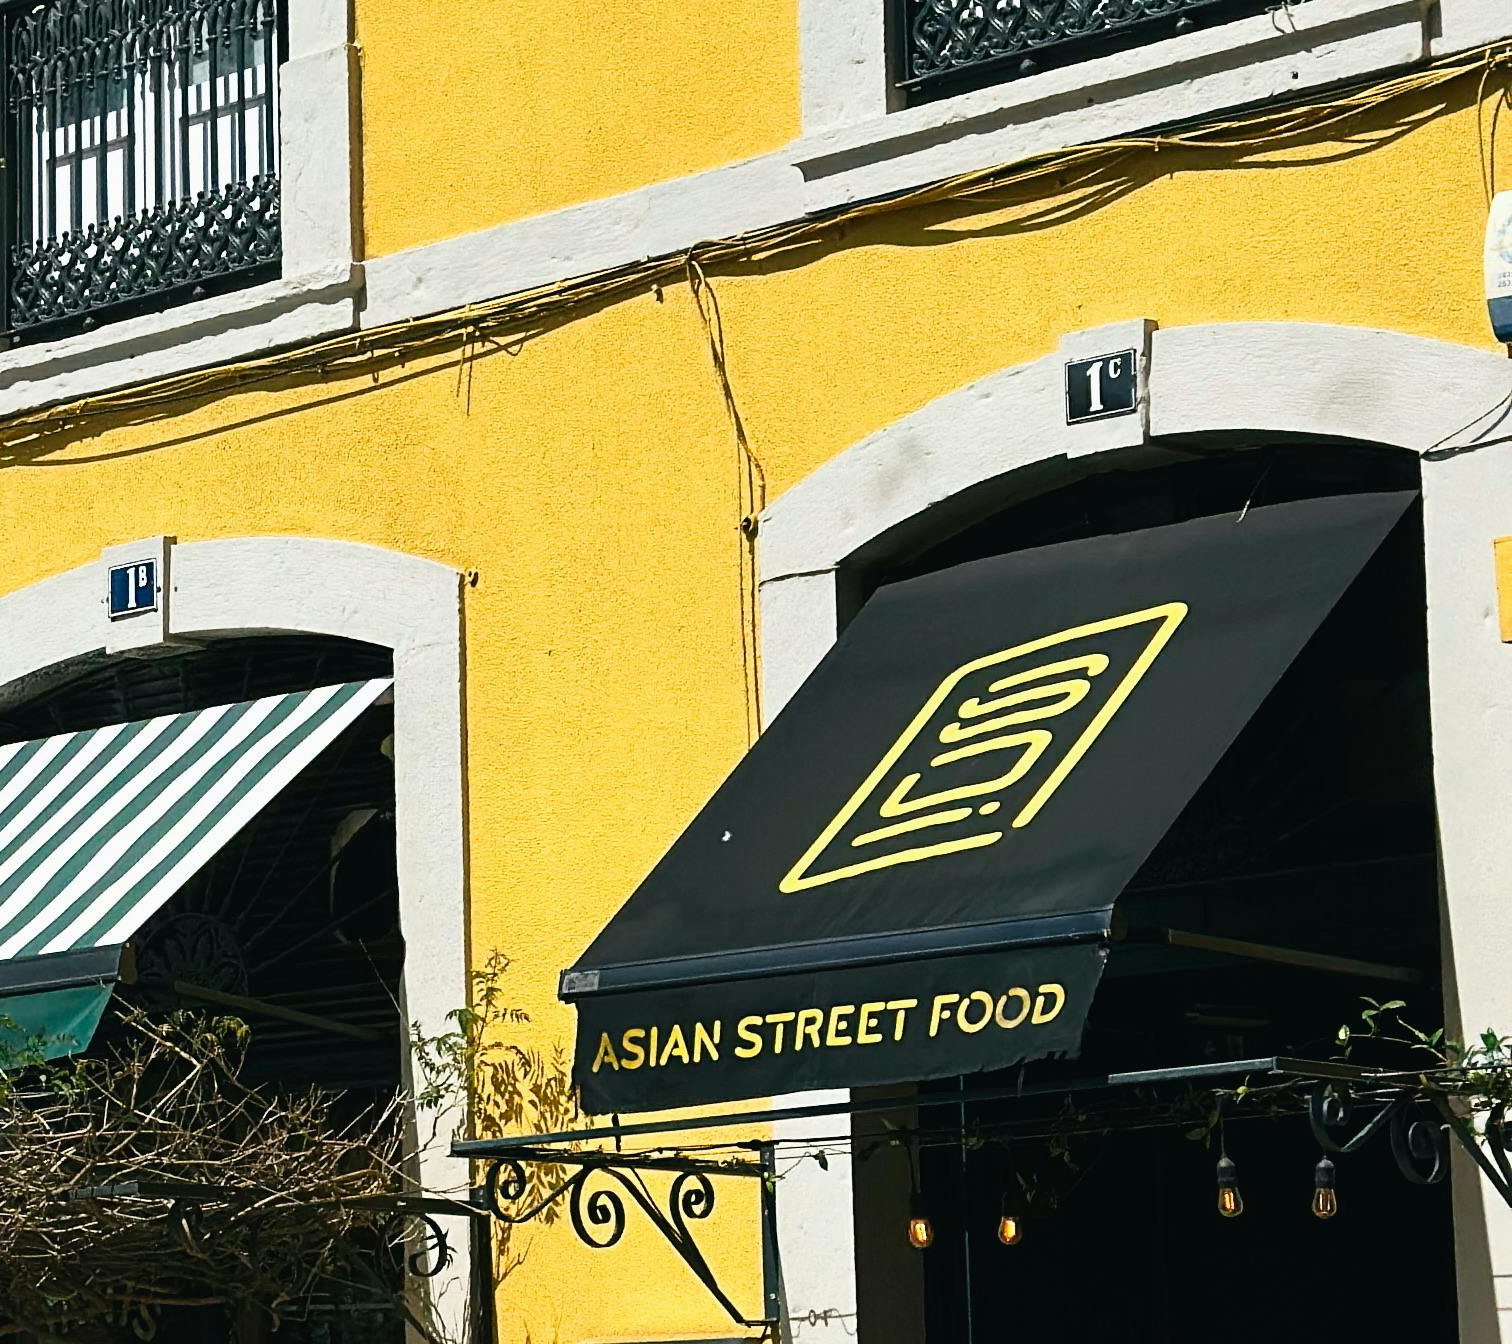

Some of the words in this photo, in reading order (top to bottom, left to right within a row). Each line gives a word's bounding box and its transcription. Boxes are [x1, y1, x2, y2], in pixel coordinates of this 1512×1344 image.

[1086, 357, 1122, 412] 1C
[126, 565, 148, 609] 1B
[591, 1019, 722, 1073] ASIAN
[734, 997, 919, 1059] STREET
[928, 982, 1067, 1038] FOOD
